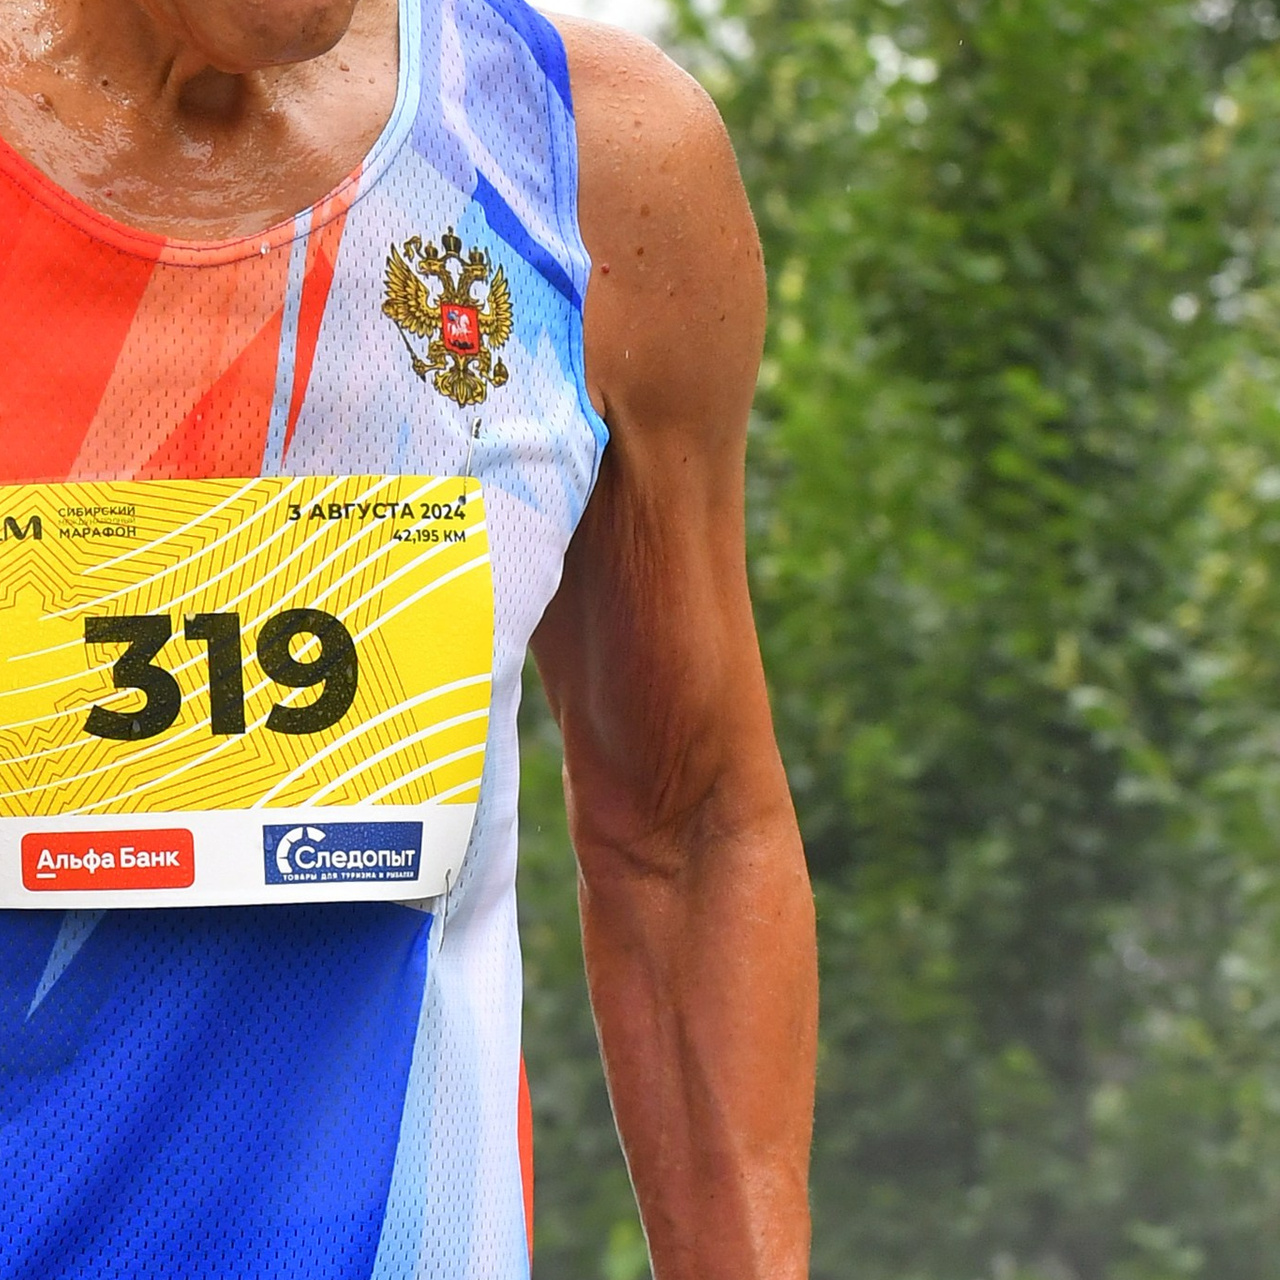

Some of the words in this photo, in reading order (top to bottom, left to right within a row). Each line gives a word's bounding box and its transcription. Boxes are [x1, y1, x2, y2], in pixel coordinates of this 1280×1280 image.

[288, 504, 301, 520] 3
[310, 503, 415, 520] АВГУСТА
[421, 503, 466, 519] 2024
[59, 526, 136, 538] МАРАФОН
[393, 529, 439, 543] 42,195
[444, 529, 466, 542] КМ
[82, 607, 359, 741] 319
[36, 848, 115, 874] Альфа
[120, 847, 180, 868] Банк
[295, 845, 416, 869] Следопыт
[282, 873, 317, 881] ТОВАРЫ
